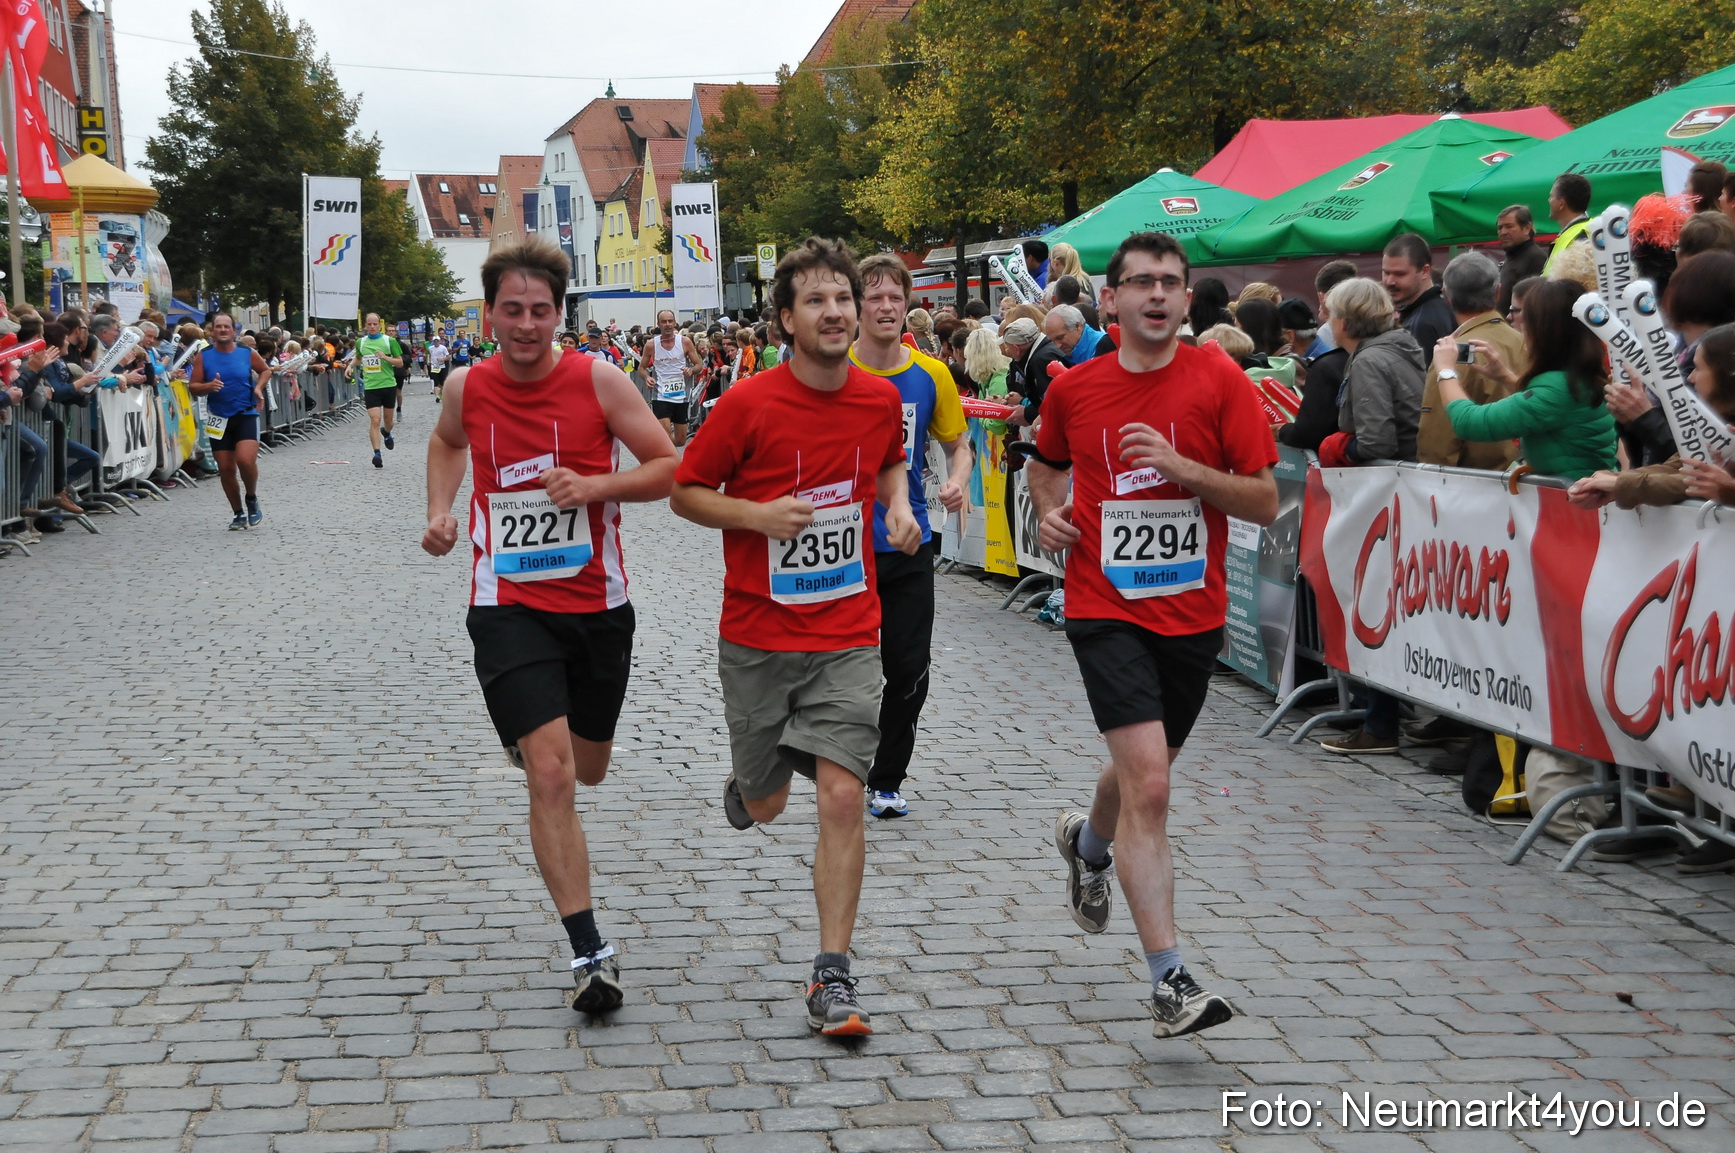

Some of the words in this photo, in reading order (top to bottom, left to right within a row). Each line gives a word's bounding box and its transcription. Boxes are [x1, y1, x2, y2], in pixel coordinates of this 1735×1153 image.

[313, 199, 358, 214] swn
[1144, 217, 1226, 229] Neumarkte
[1609, 328, 1651, 377] BMW
[1647, 327, 1680, 380] BMW
[664, 382, 683, 392] 2467
[514, 463, 539, 478] DEHN
[1132, 471, 1157, 485] DEHN
[812, 489, 837, 502] DEHN
[491, 501, 520, 511] PARTL
[522, 500, 556, 509] Neuma
[1104, 510, 1138, 520] PARTL
[1140, 510, 1191, 519] Neumarkt
[501, 508, 578, 548] 2227
[780, 526, 855, 569] 2350
[1113, 522, 1198, 561] 2294
[519, 554, 566, 570] Florian
[1134, 569, 1178, 585] Martin
[1351, 492, 1516, 650] Charivari
[795, 571, 845, 592] Raphael
[1601, 541, 1735, 742] Cha
[1404, 642, 1480, 696] Ostbayerns
[1484, 667, 1533, 712] Radio
